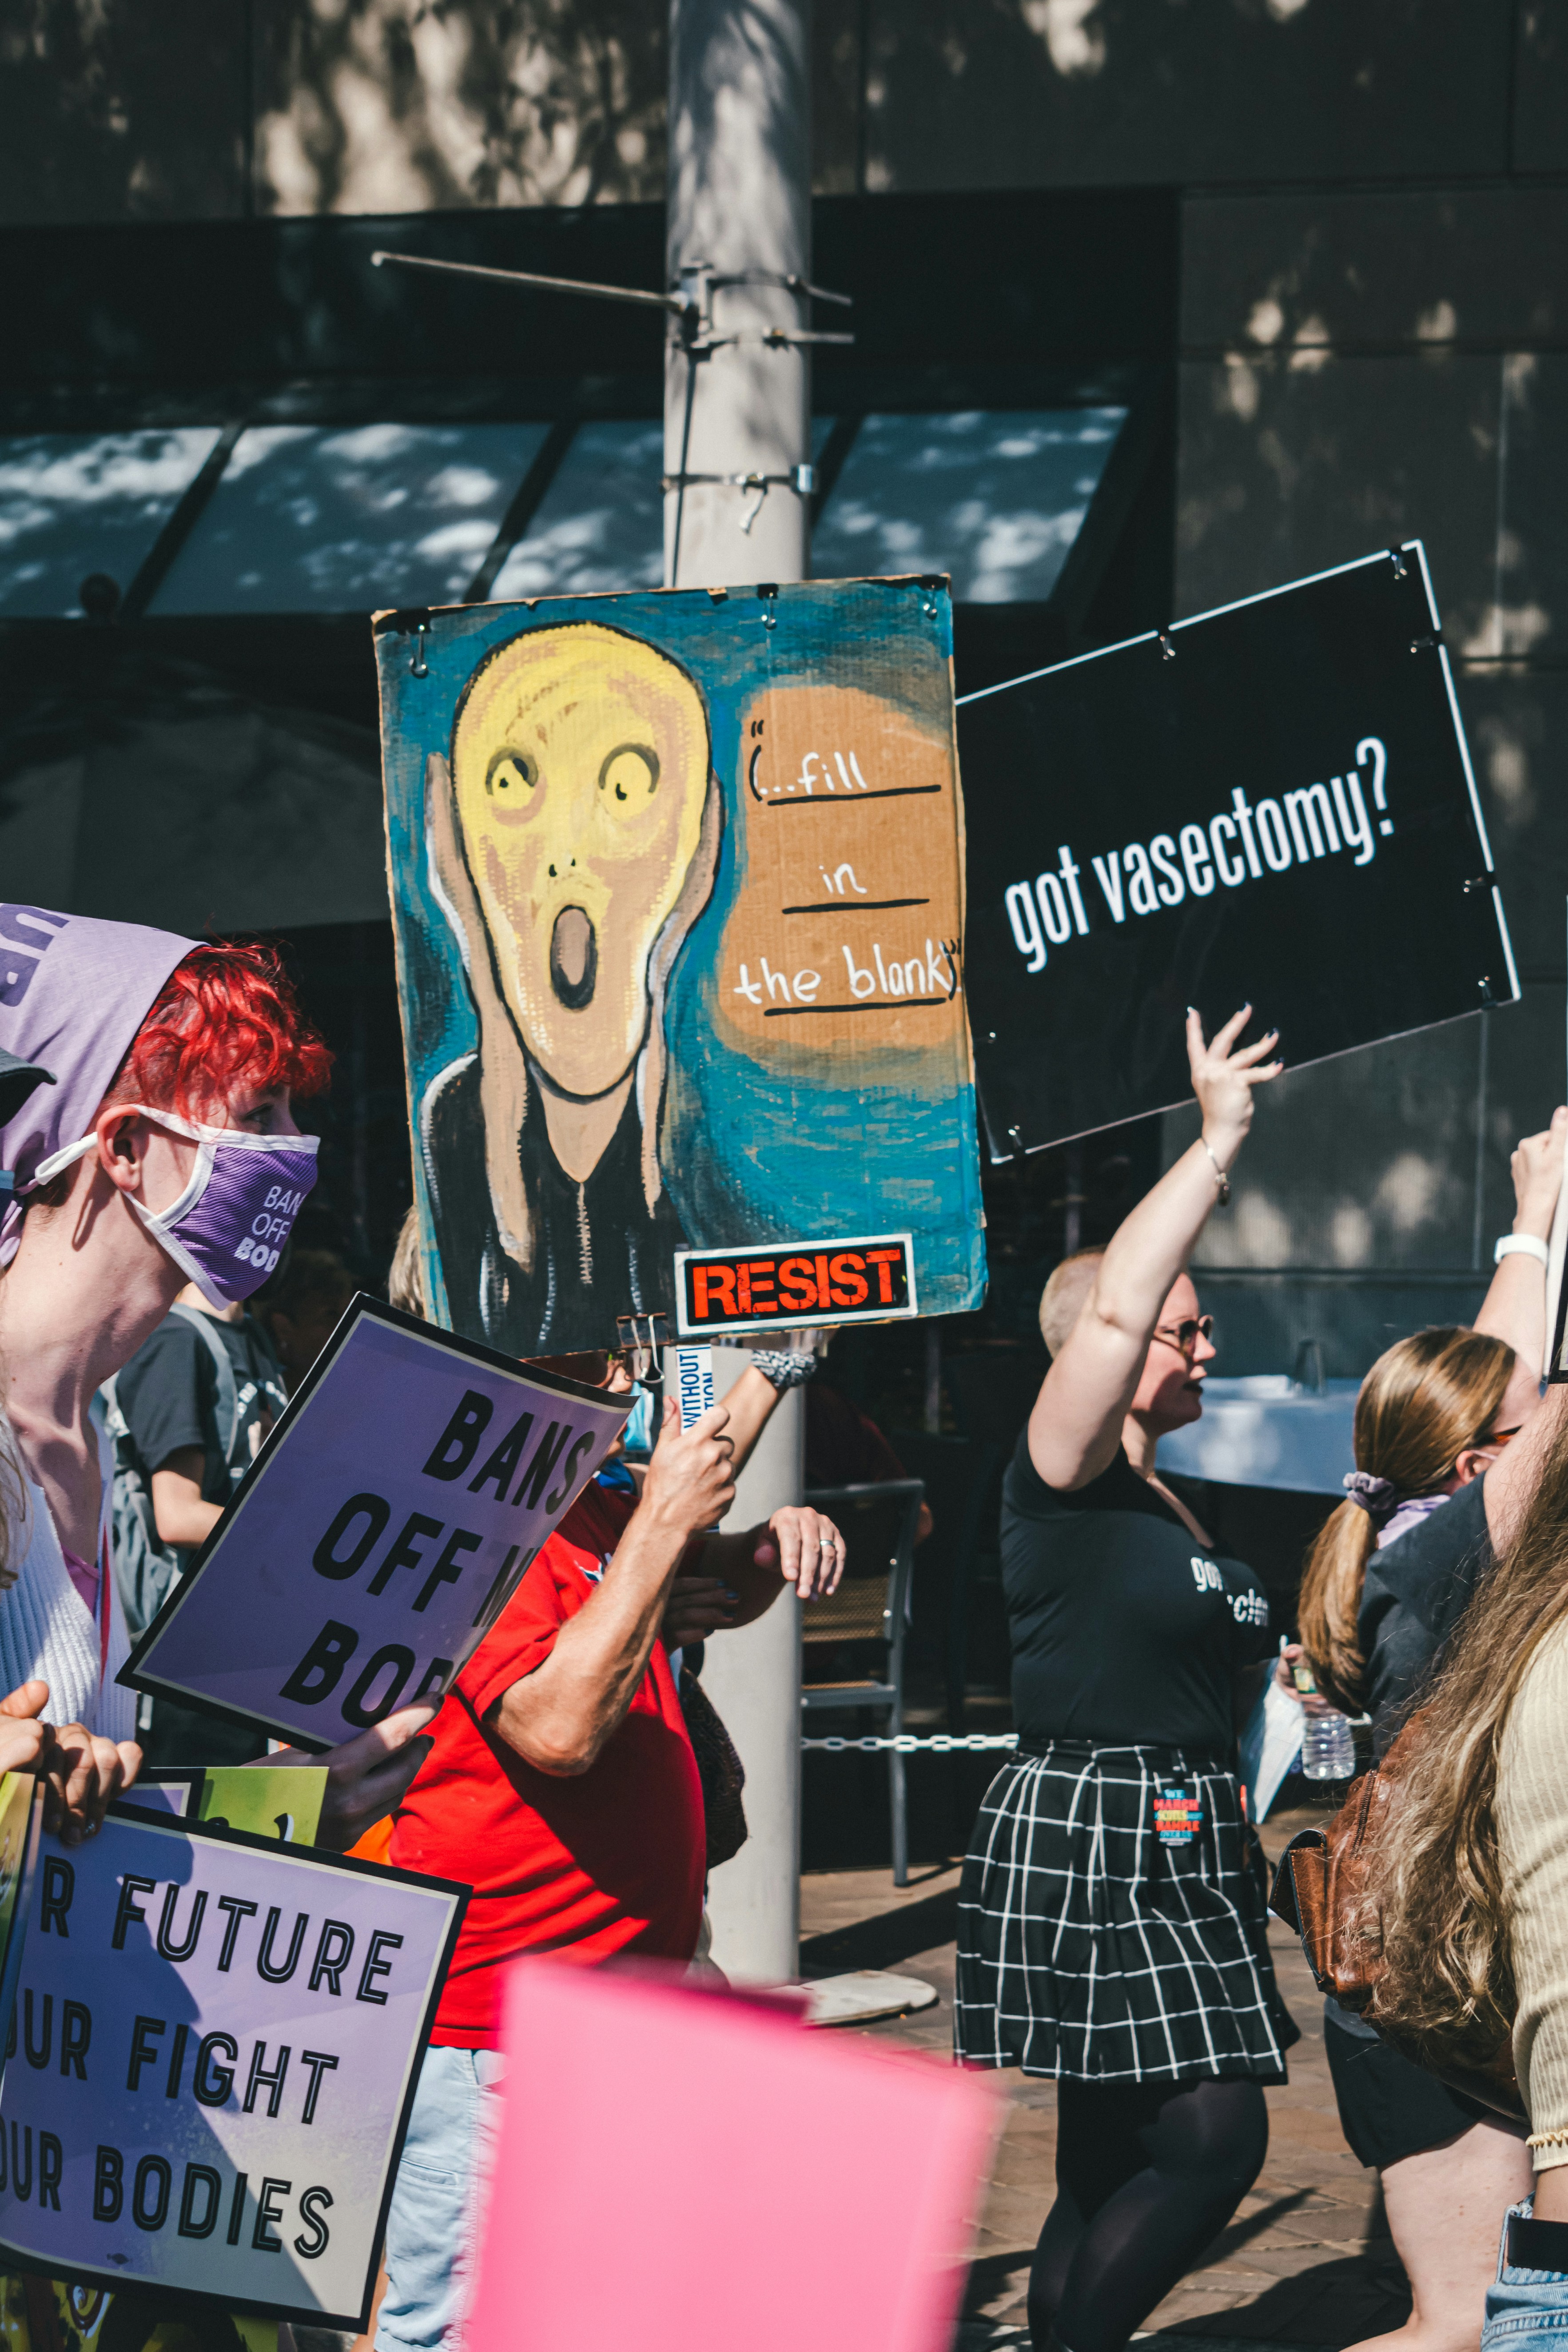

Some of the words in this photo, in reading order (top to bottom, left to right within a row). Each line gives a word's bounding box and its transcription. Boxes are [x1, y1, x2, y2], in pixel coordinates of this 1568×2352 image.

[819, 863, 867, 895] in
[1005, 845, 1090, 973] got
[1091, 736, 1394, 923] vasectomy?
[734, 957, 821, 1004] the
[252, 1213, 291, 1242] OFF
[693, 1249, 901, 1318] RESIST
[679, 1354, 702, 1429] WITHOUT
[422, 1389, 596, 1516] BANS
[312, 1492, 484, 1613] OFF
[111, 1873, 404, 2006] FUTURE
[126, 2014, 340, 2125] FIGHT
[92, 2144, 334, 2260] BODIES
